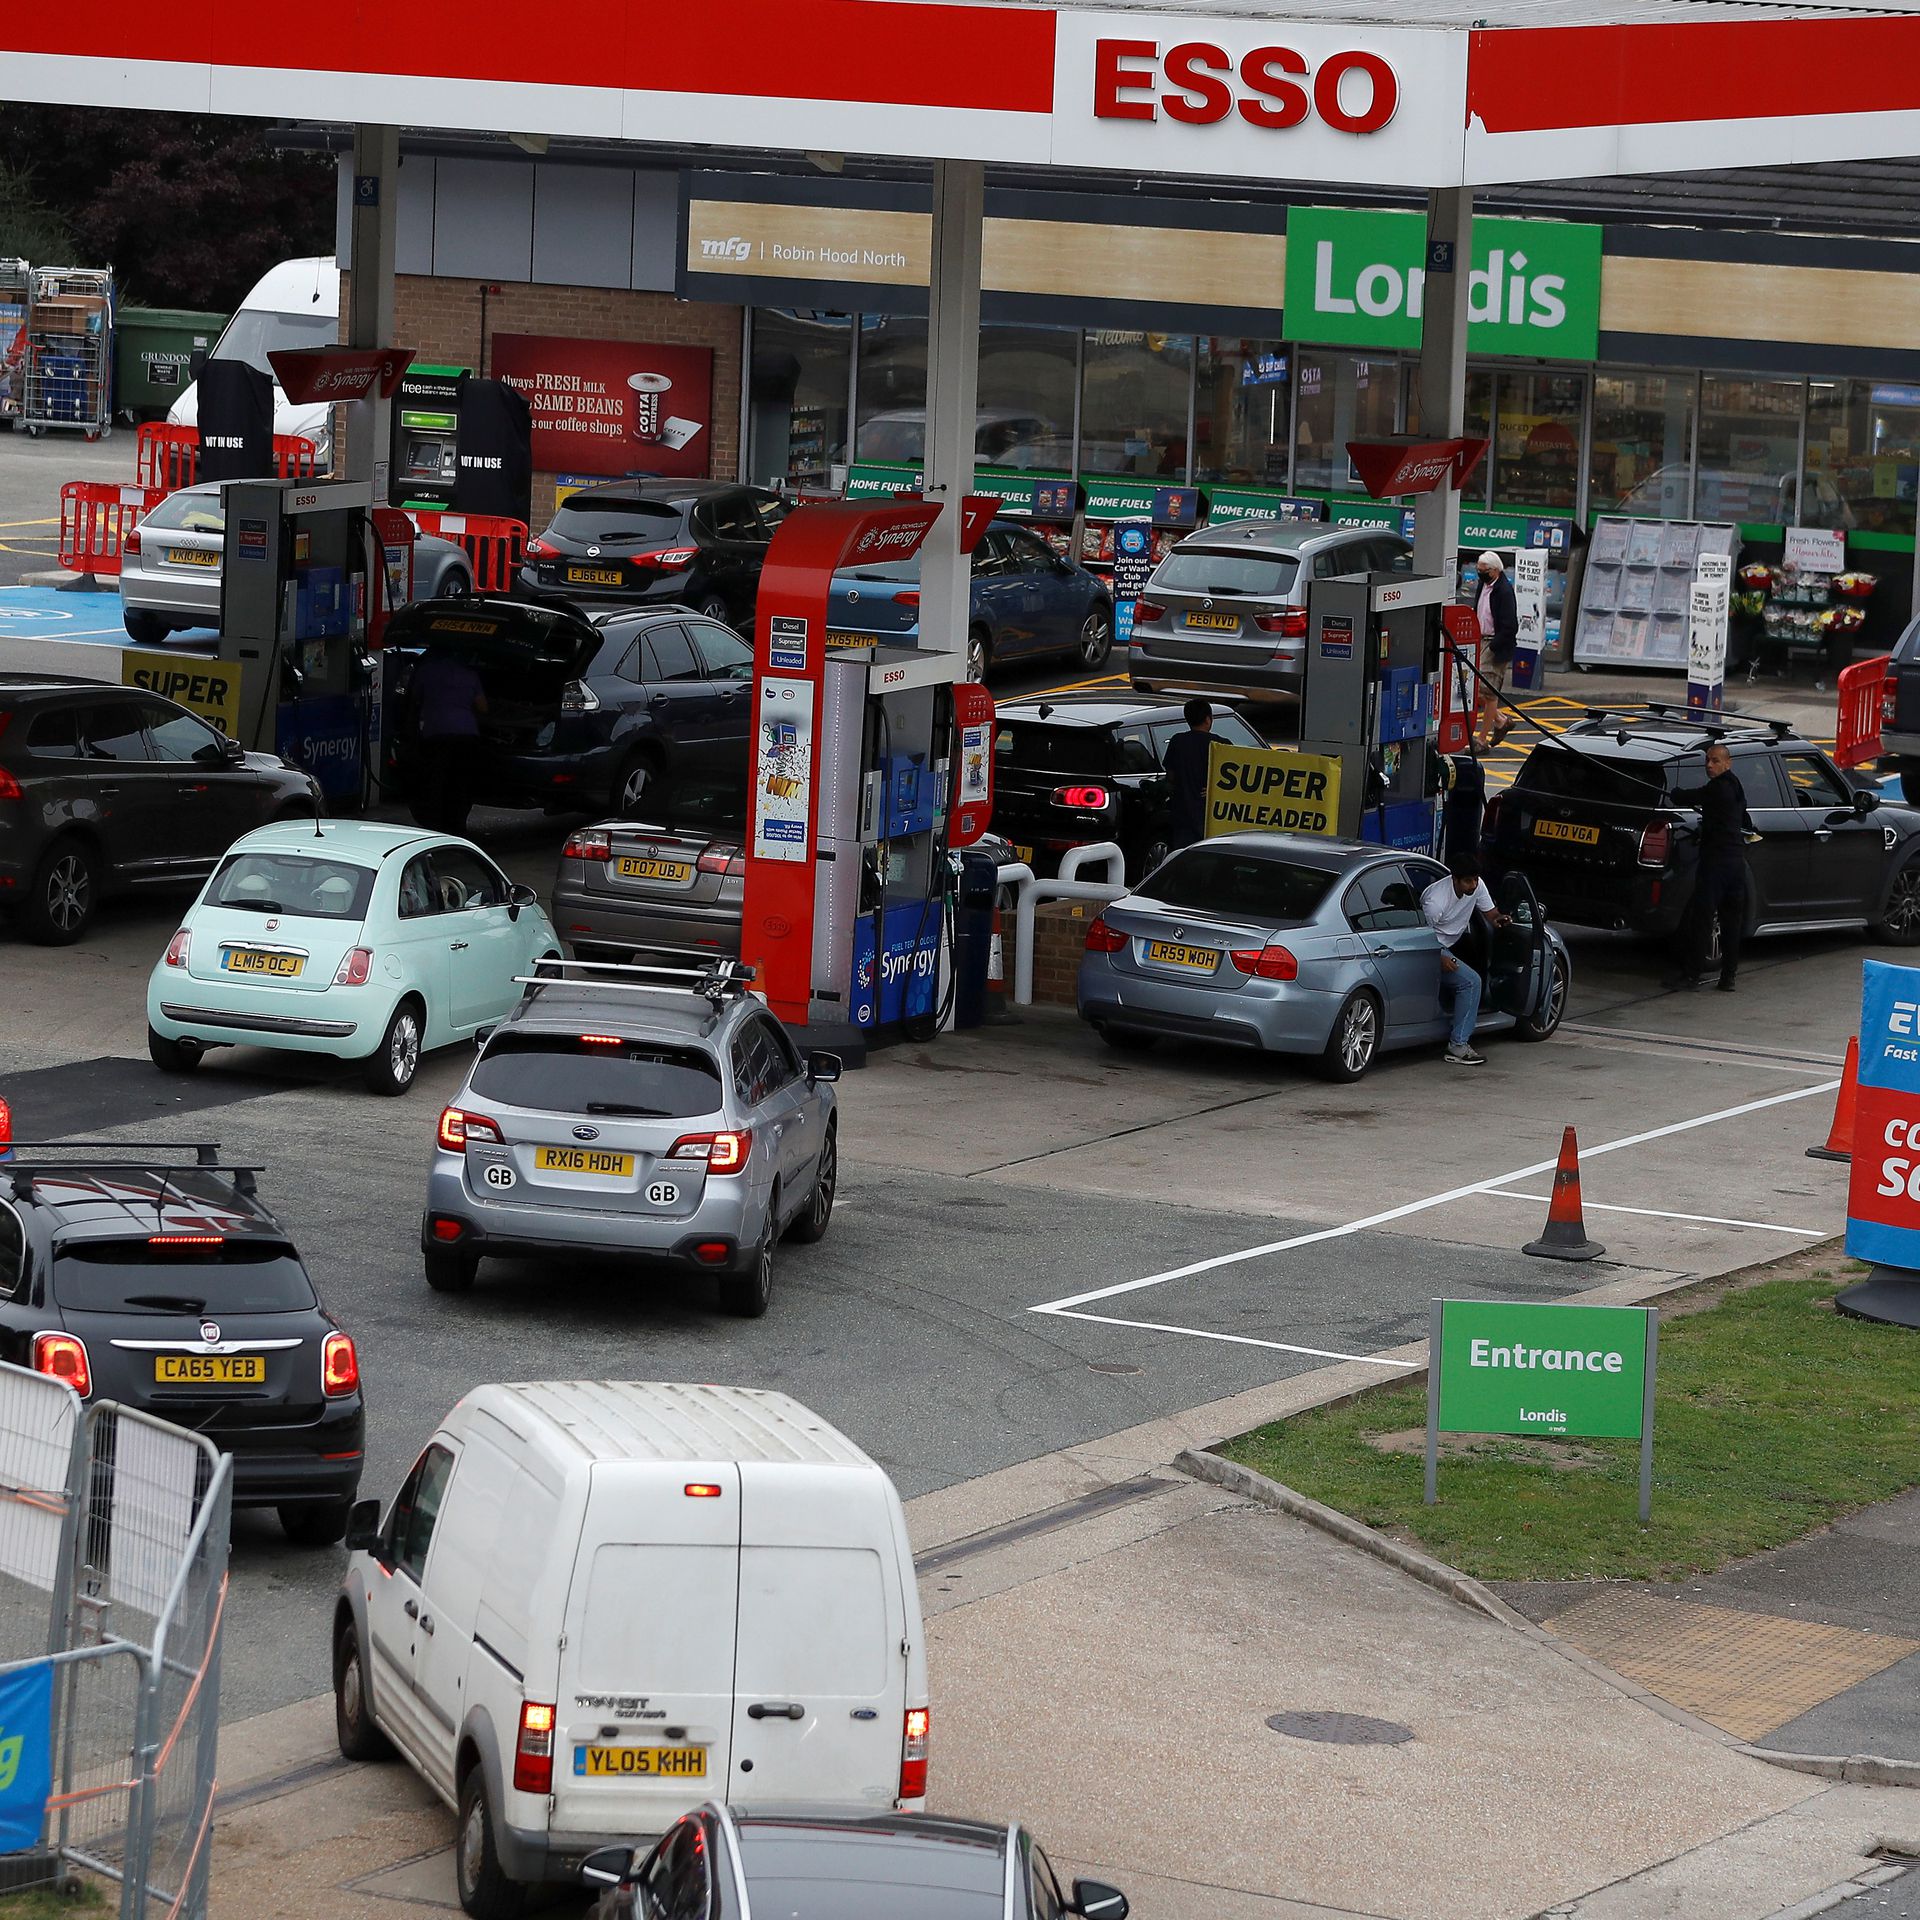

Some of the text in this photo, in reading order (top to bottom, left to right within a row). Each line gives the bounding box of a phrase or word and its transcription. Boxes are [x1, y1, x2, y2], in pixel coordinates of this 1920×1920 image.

[1094, 38, 1401, 134] ESSO
[701, 237, 905, 267] mfg Robin Hood North
[141, 352, 191, 362] GRUNDON
[384, 362, 393, 376] 3
[330, 372, 375, 390] Synergy
[402, 381, 422, 394] free
[501, 373, 606, 393] Always FRESH MILK
[534, 393, 624, 416] SAME BEANS
[640, 393, 650, 433] COSTA
[538, 416, 623, 437] our coffee shops
[226, 437, 243, 448] USE
[474, 456, 502, 468] IN USE
[1456, 451, 1464, 467] 1
[1409, 462, 1445, 482] Synergy
[850, 479, 912, 492] HOME FUELS
[296, 496, 316, 506] ESSO
[1000, 492, 1032, 503] FUELS
[1088, 496, 1152, 510] HOME FUELS
[1211, 504, 1277, 520] HOME FUELS
[965, 512, 977, 528] 7
[1337, 517, 1391, 530] CAR CARE
[874, 529, 921, 550] Synergy
[1464, 526, 1518, 540] CAR CARE
[173, 549, 215, 563] VK10 PXR
[1117, 556, 1133, 564] Join
[571, 568, 617, 583] EJ66 LKE
[1133, 582, 1146, 590] get
[1383, 590, 1401, 602] ESSO
[782, 622, 799, 630] Diesel
[1189, 613, 1234, 627] FE61 VVD
[321, 624, 326, 634] 3
[1119, 627, 1131, 635] FR
[826, 633, 873, 647] RY65 HTG
[776, 656, 802, 665] Unleaded
[883, 670, 905, 683] ESSO
[304, 735, 357, 766] Synergy
[1216, 762, 1328, 801] SUPER
[1213, 801, 1328, 832] UNLEADED
[903, 820, 909, 832] 7
[1539, 821, 1569, 837] LL70
[1571, 826, 1594, 842] VGA
[623, 859, 685, 878] BT07 UBJ
[891, 942, 904, 951] FUEL
[233, 953, 298, 972] LM15 OCJ
[1151, 947, 1216, 967] LR59 WOH
[1884, 1044, 1918, 1062] Fast
[546, 1149, 624, 1173] RX16 HDH
[488, 1168, 512, 1185] GB
[650, 1185, 675, 1201] GB
[1470, 1338, 1623, 1373] Entrance
[164, 1359, 255, 1378] CA65 YEB
[1519, 1407, 1567, 1422] Londis
[574, 1695, 650, 1709] TRANSIT
[591, 1750, 702, 1772] YL05 KHH
